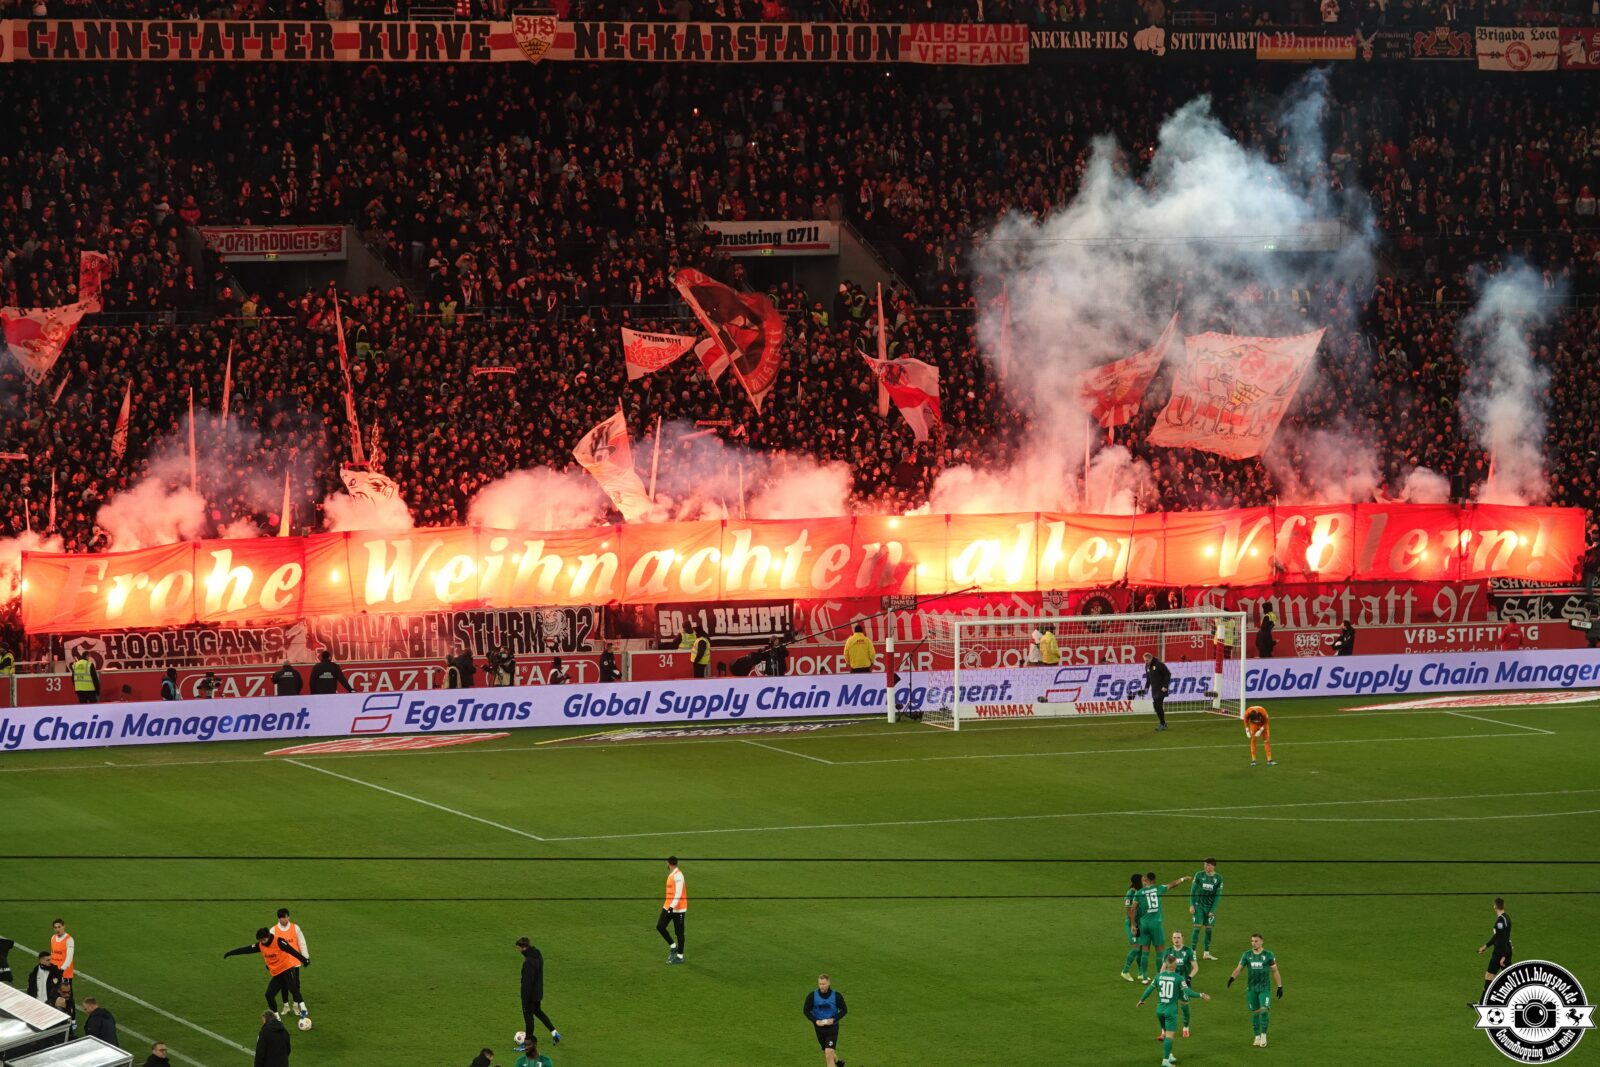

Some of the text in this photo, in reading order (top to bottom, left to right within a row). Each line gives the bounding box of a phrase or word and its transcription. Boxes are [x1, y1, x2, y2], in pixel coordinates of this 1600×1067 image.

[27, 21, 490, 61] CANNSTATTER KURVE
[573, 23, 901, 61] NECKARSTADION
[915, 23, 1027, 42] ALBSTADT
[1031, 31, 1257, 50] NECKAR-FILS STUTTGART
[1477, 28, 1557, 43] Brigada Loca
[918, 44, 1025, 63] VFB-FANS
[225, 233, 255, 251] 0711
[259, 232, 320, 250] ADDICTS
[787, 227, 819, 243] 0711
[60, 549, 303, 620] Frohe
[364, 529, 903, 604] Weihnachten
[952, 521, 1157, 585] allen
[1433, 584, 1480, 624] 97
[713, 605, 791, 634] BLEIBT!
[562, 607, 593, 653] 02
[102, 628, 284, 659] HOOLIGANS
[1190, 635, 1204, 649] 35
[659, 655, 673, 668] 34
[46, 678, 61, 691] 33
[1245, 667, 1322, 692] Global
[1326, 663, 1413, 693] Supply
[1419, 662, 1490, 687] Chain
[563, 680, 1012, 718] Global Supply Chain Management.
[1075, 702, 1133, 714] WINAMAX
[405, 698, 533, 731] EgeTrans
[976, 705, 1034, 717] WINAMAX
[33, 715, 114, 742] Chain
[120, 707, 311, 740] Management.
[1146, 892, 1159, 909] 19
[1159, 981, 1174, 999] 30
